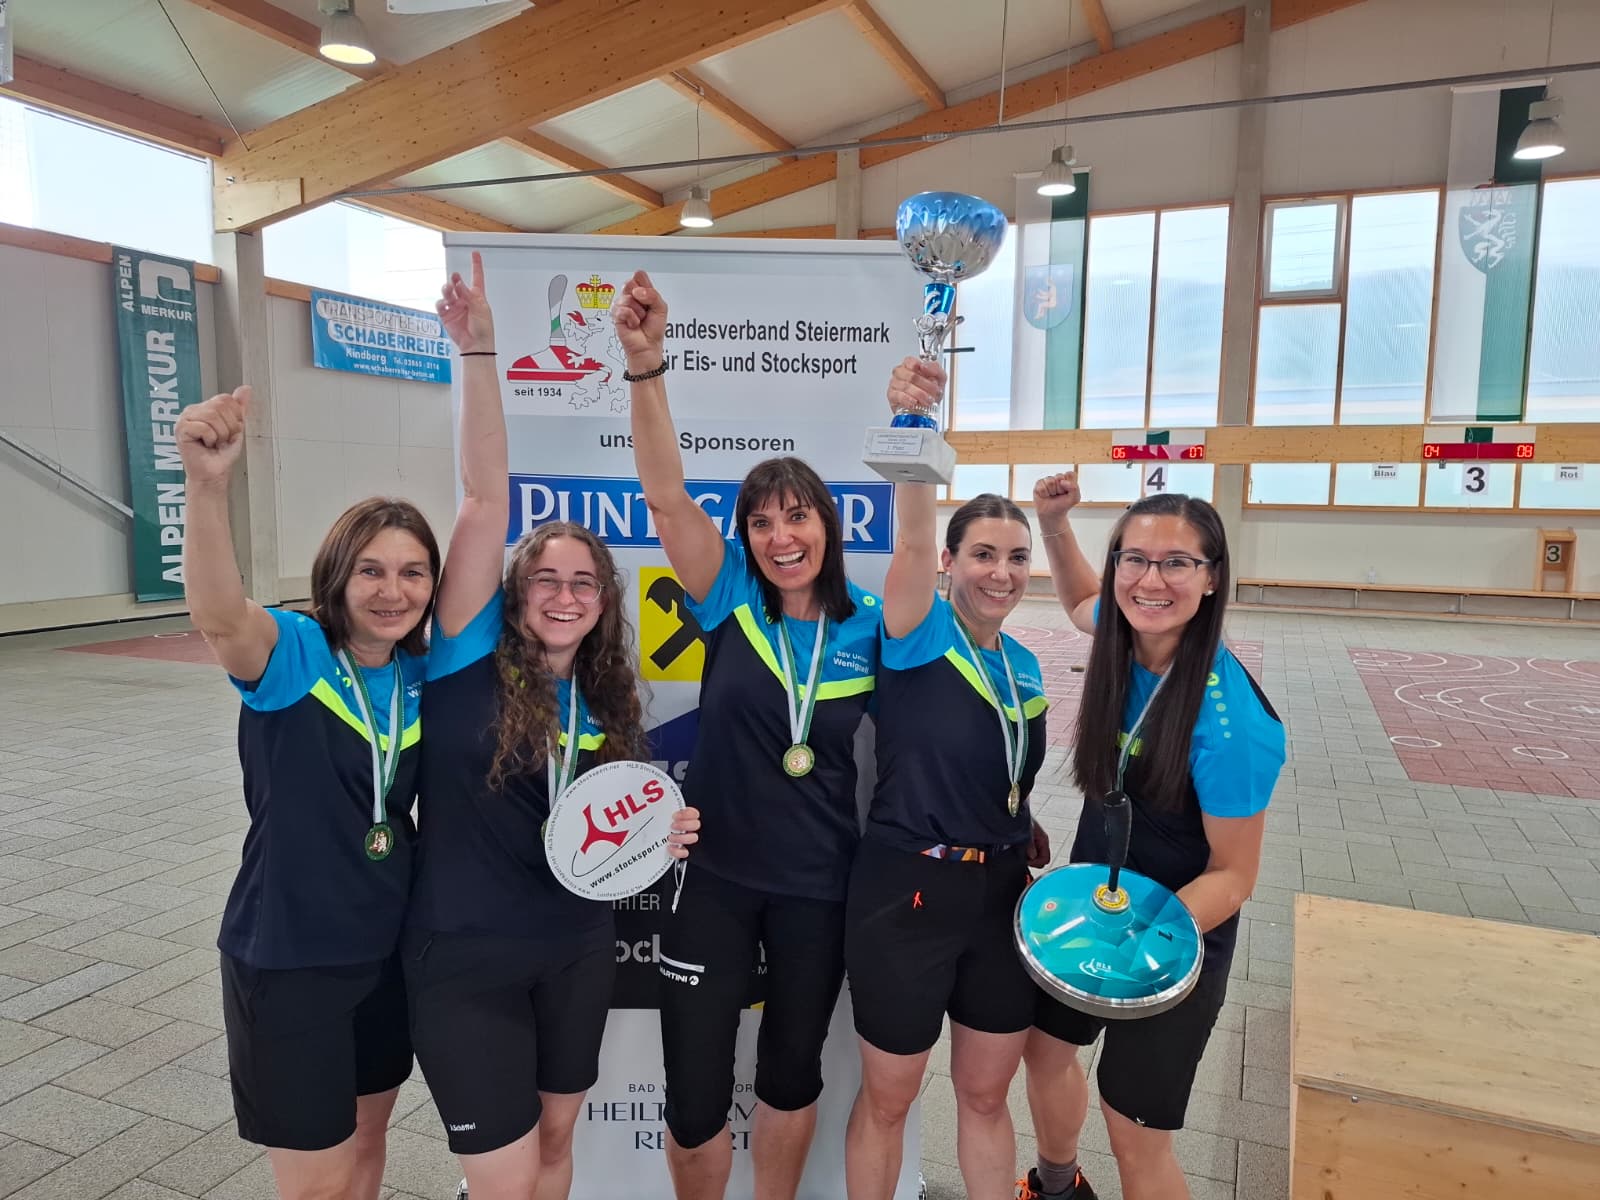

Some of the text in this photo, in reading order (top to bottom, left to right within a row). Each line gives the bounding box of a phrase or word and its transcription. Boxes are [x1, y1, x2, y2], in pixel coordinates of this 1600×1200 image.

[119, 255, 134, 312] ALPEN
[141, 304, 192, 321] MERKUR
[321, 300, 438, 334] TRANSPORTBETON
[664, 318, 890, 343] andesverband Steiermark
[684, 350, 717, 372] Eis-
[722, 352, 755, 373] und
[761, 351, 857, 379] Stocksport
[514, 387, 562, 397] seit 1934
[600, 432, 795, 453] uns Sponsoren
[1424, 445, 1439, 457] 04
[146, 330, 186, 585] ALPEN MERKUR
[1147, 467, 1165, 491] 4
[1374, 470, 1396, 478] Blau
[1465, 467, 1485, 492] 3
[1546, 546, 1560, 562] 3
[603, 779, 665, 828] HLS
[589, 834, 672, 889] www.stocksport.n
[629, 1084, 656, 1093] BAD
